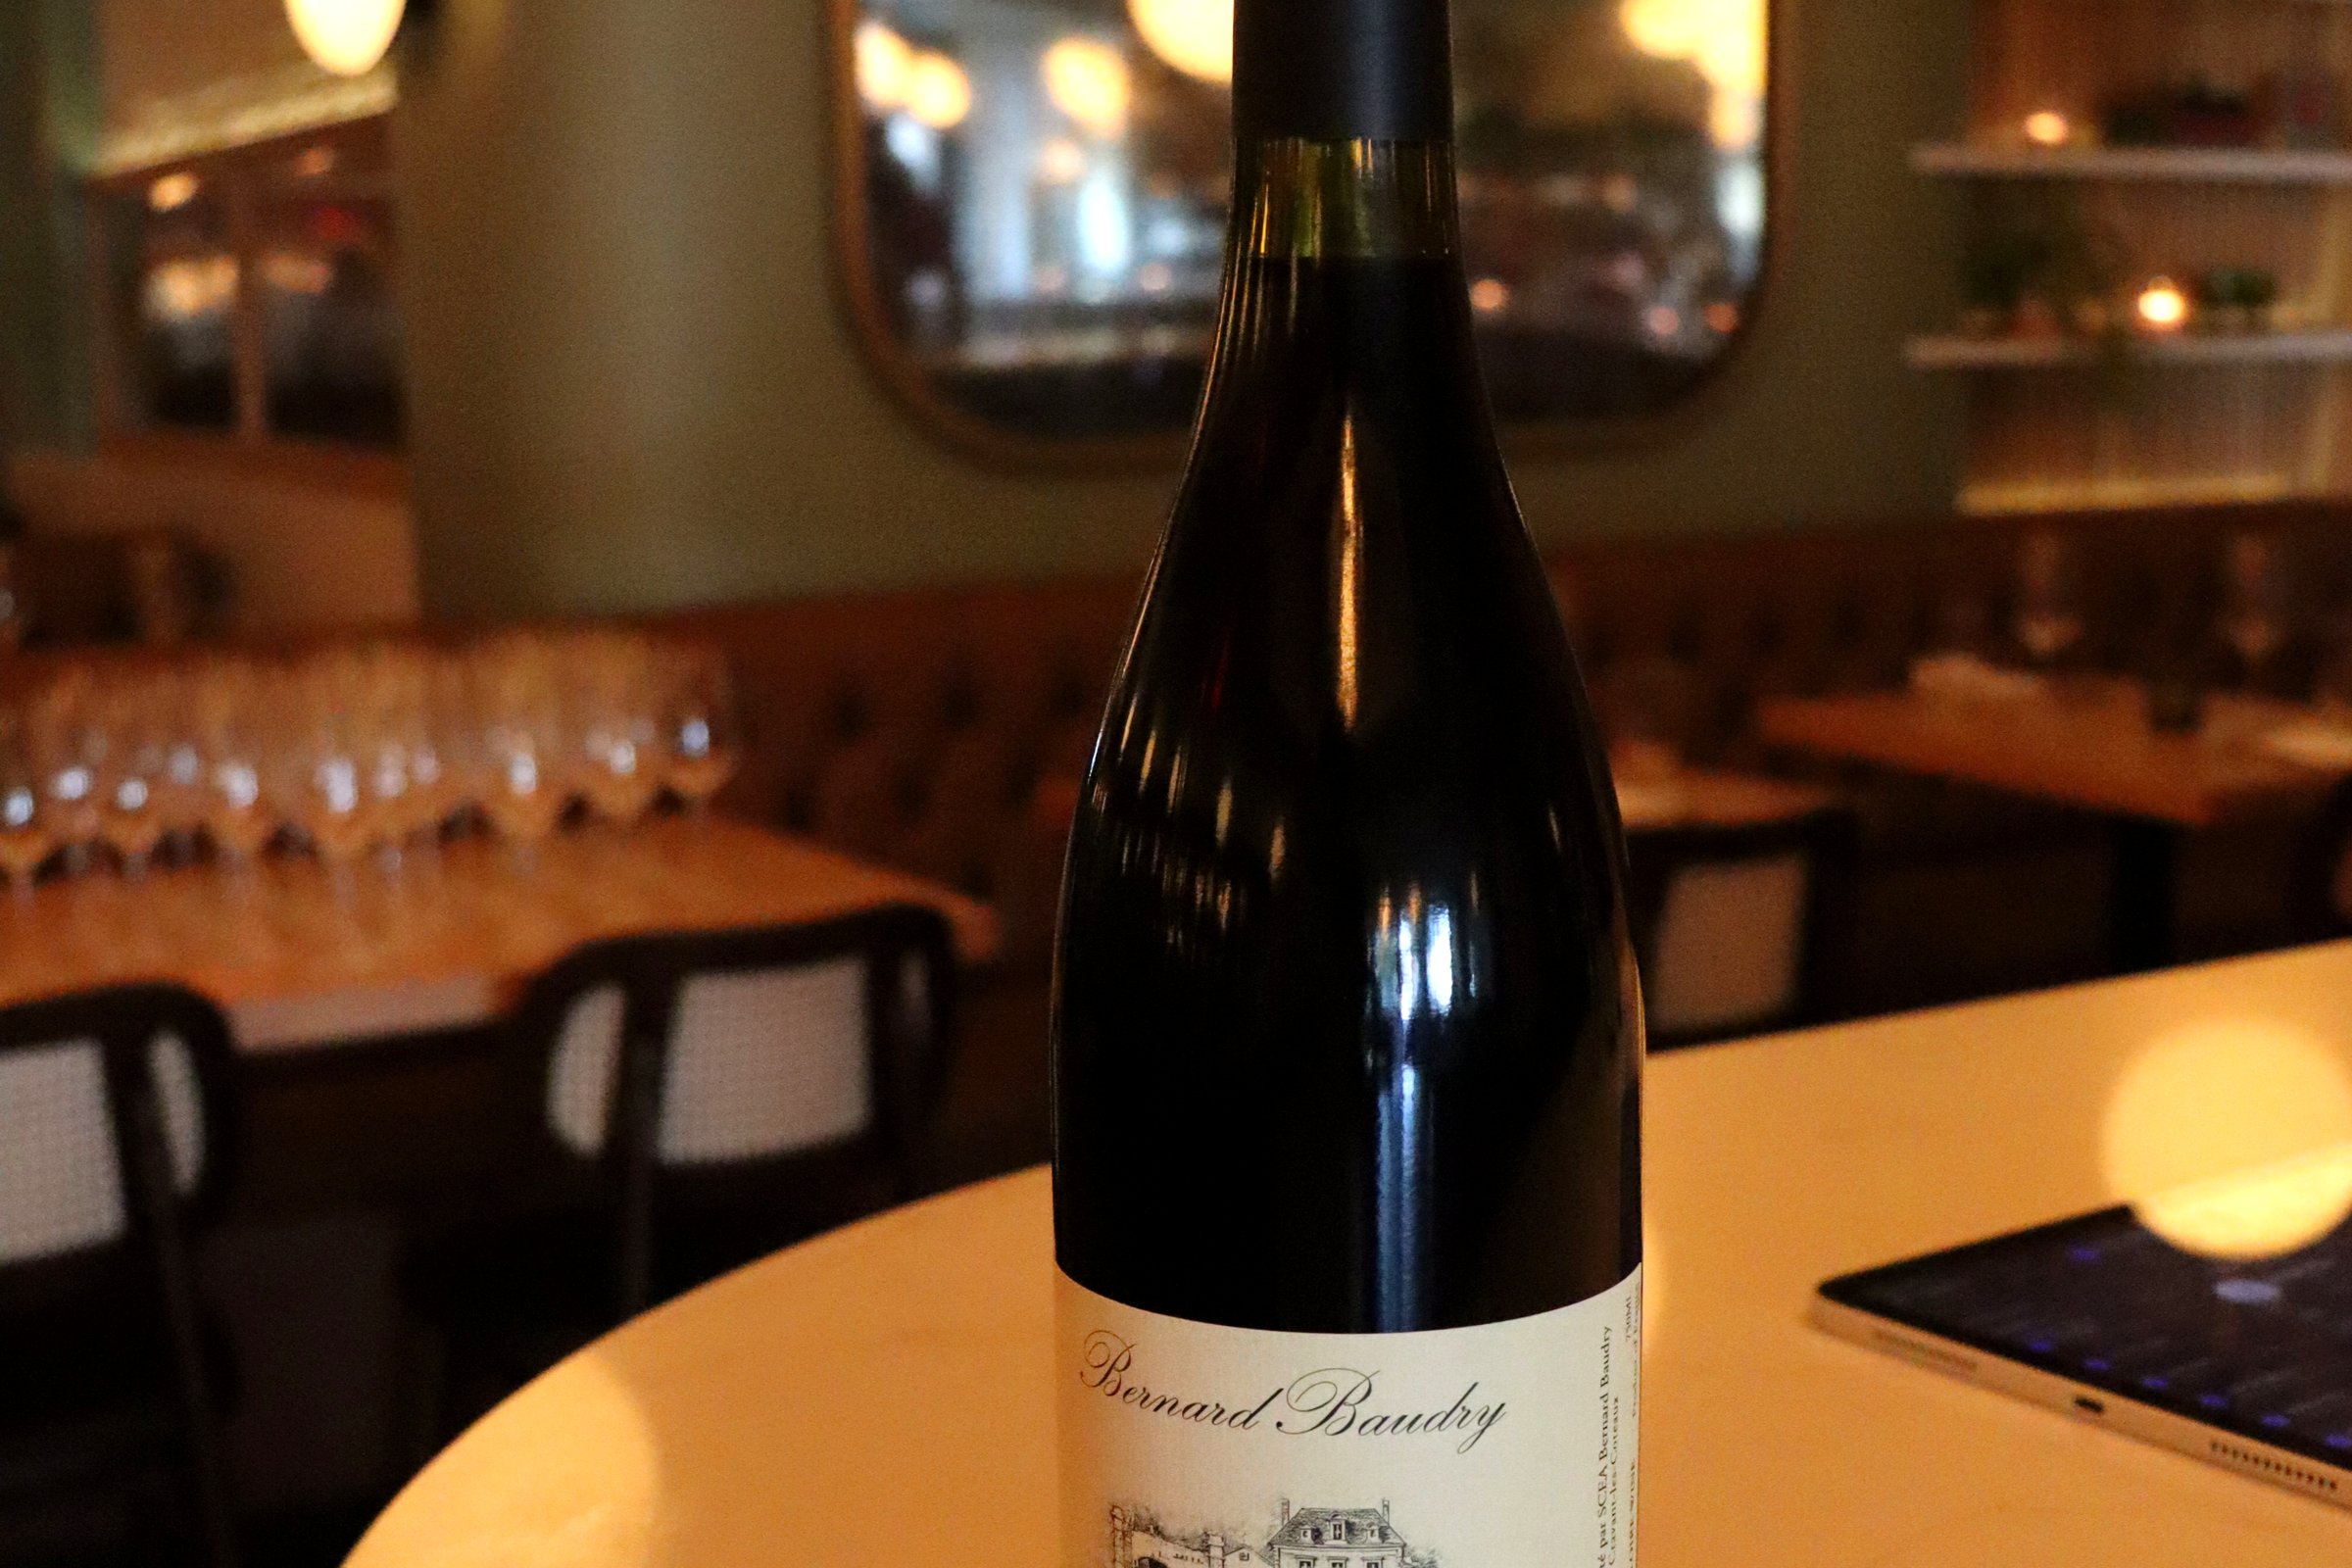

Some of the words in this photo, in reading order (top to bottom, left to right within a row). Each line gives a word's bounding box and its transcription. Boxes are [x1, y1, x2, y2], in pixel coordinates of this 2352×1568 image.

[1600, 1326, 1612, 1388] Baudry
[1080, 1330, 1283, 1430] Bernard
[1276, 1368, 1506, 1454] Baudry
[1598, 1392, 1608, 1461] Bernard
[1597, 1464, 1608, 1518] SCEA
[1599, 1523, 1608, 1548] par
